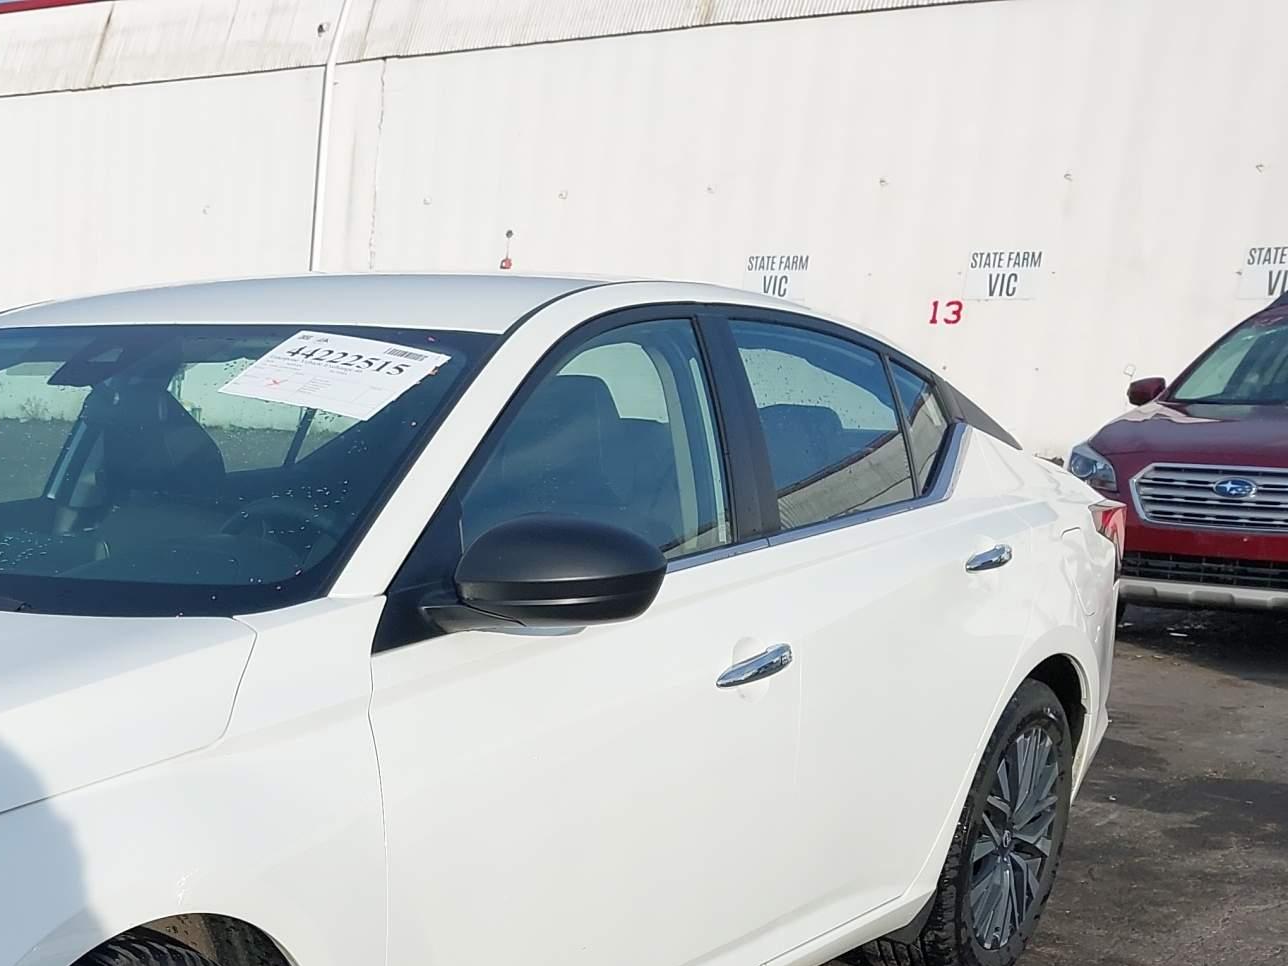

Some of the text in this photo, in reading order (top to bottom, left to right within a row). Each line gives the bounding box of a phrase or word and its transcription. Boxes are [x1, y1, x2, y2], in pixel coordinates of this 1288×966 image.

[747, 255, 809, 271] STATE FARM
[970, 251, 1042, 269] STATE FARM
[1248, 247, 1288, 265] STATE
[763, 275, 788, 297] VIC
[988, 273, 1018, 297] VIC
[1268, 270, 1288, 296] VI
[929, 300, 963, 324] 13
[286, 345, 411, 375] 44222515
